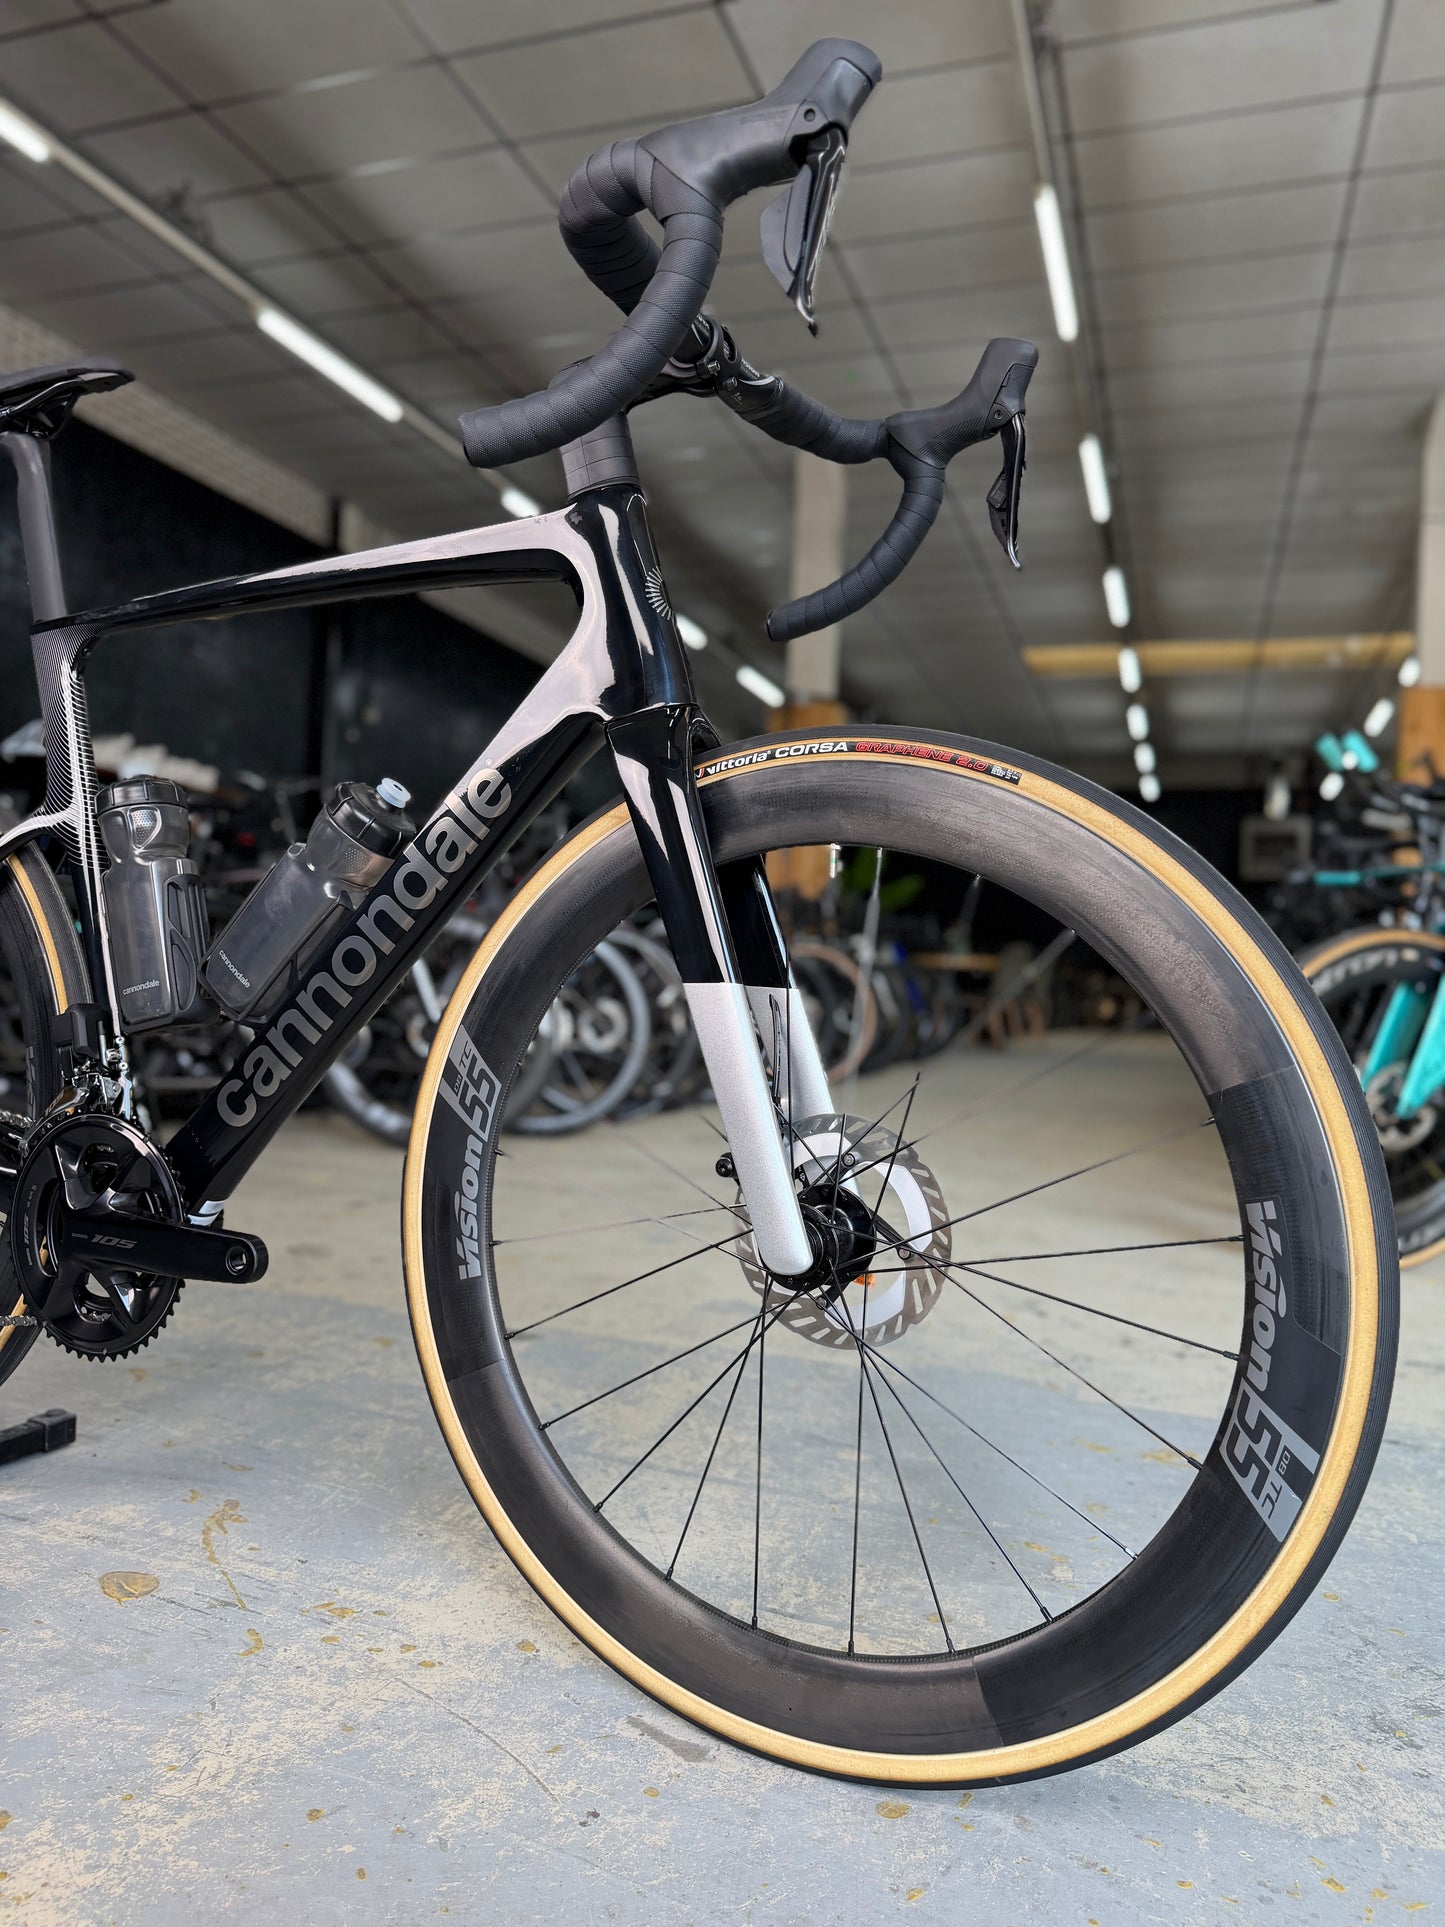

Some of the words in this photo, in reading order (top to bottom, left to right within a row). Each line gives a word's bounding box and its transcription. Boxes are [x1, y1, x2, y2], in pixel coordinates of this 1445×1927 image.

[706, 751, 768, 775] vittoria
[774, 741, 849, 758] CORSA
[855, 741, 954, 762] GRAPHENE
[955, 755, 989, 772] 2.0
[217, 768, 512, 1128] cannondale
[122, 979, 160, 996] cannondale
[219, 949, 251, 989] cannondale
[454, 1075, 462, 1093] DB
[459, 1041, 474, 1069] TC
[458, 1053, 496, 1136] 55
[91, 1233, 138, 1250] 105
[1226, 1399, 1283, 1501] 55
[1275, 1445, 1290, 1476] DB
[1261, 1482, 1284, 1520] TC
